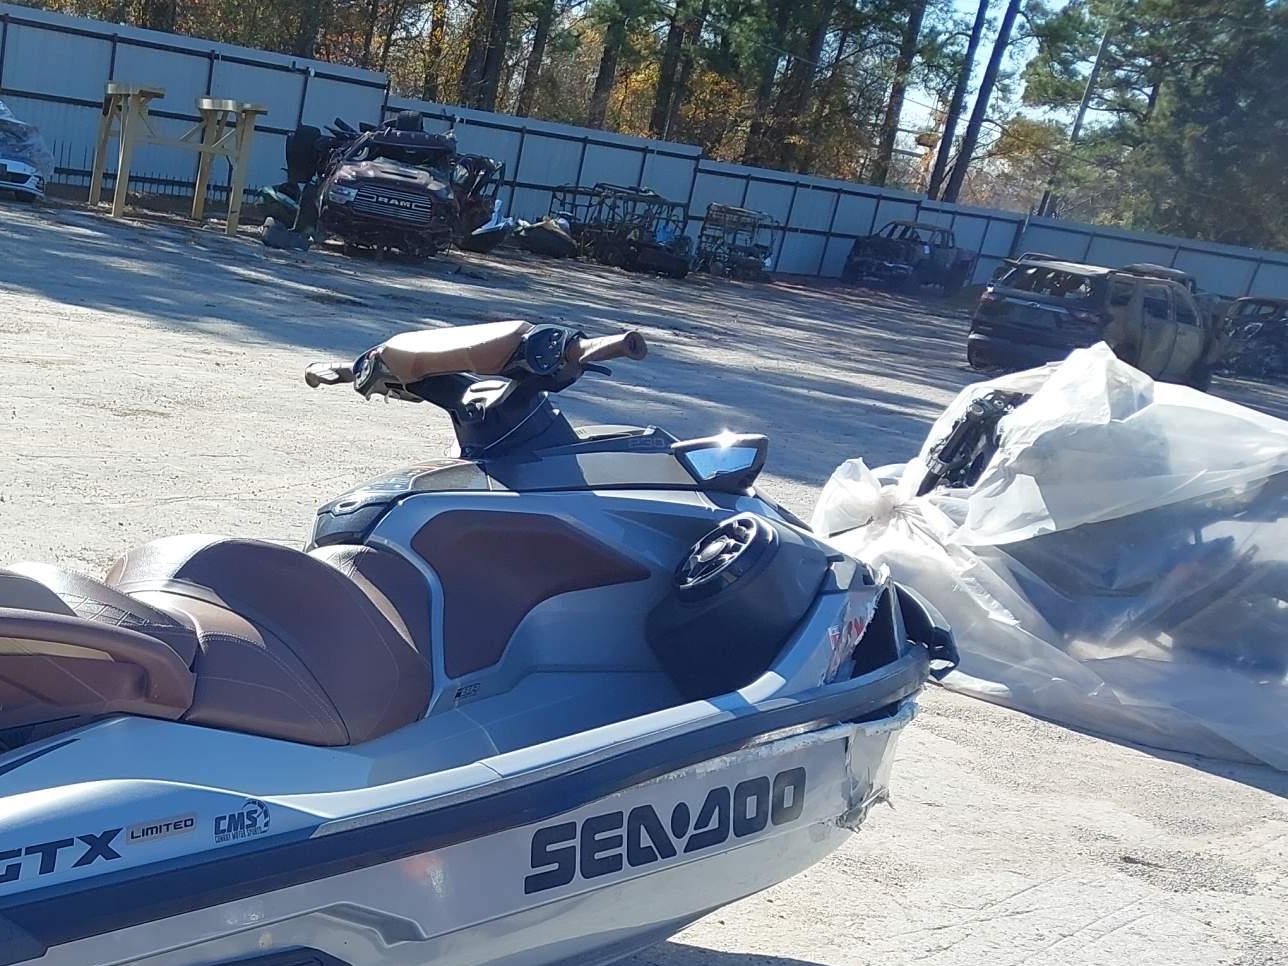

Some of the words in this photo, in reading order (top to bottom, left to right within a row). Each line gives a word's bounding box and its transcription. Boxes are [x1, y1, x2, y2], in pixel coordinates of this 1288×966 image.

[376, 195, 411, 208] RAM
[130, 817, 194, 840] LIMITED
[215, 809, 258, 835] CMS
